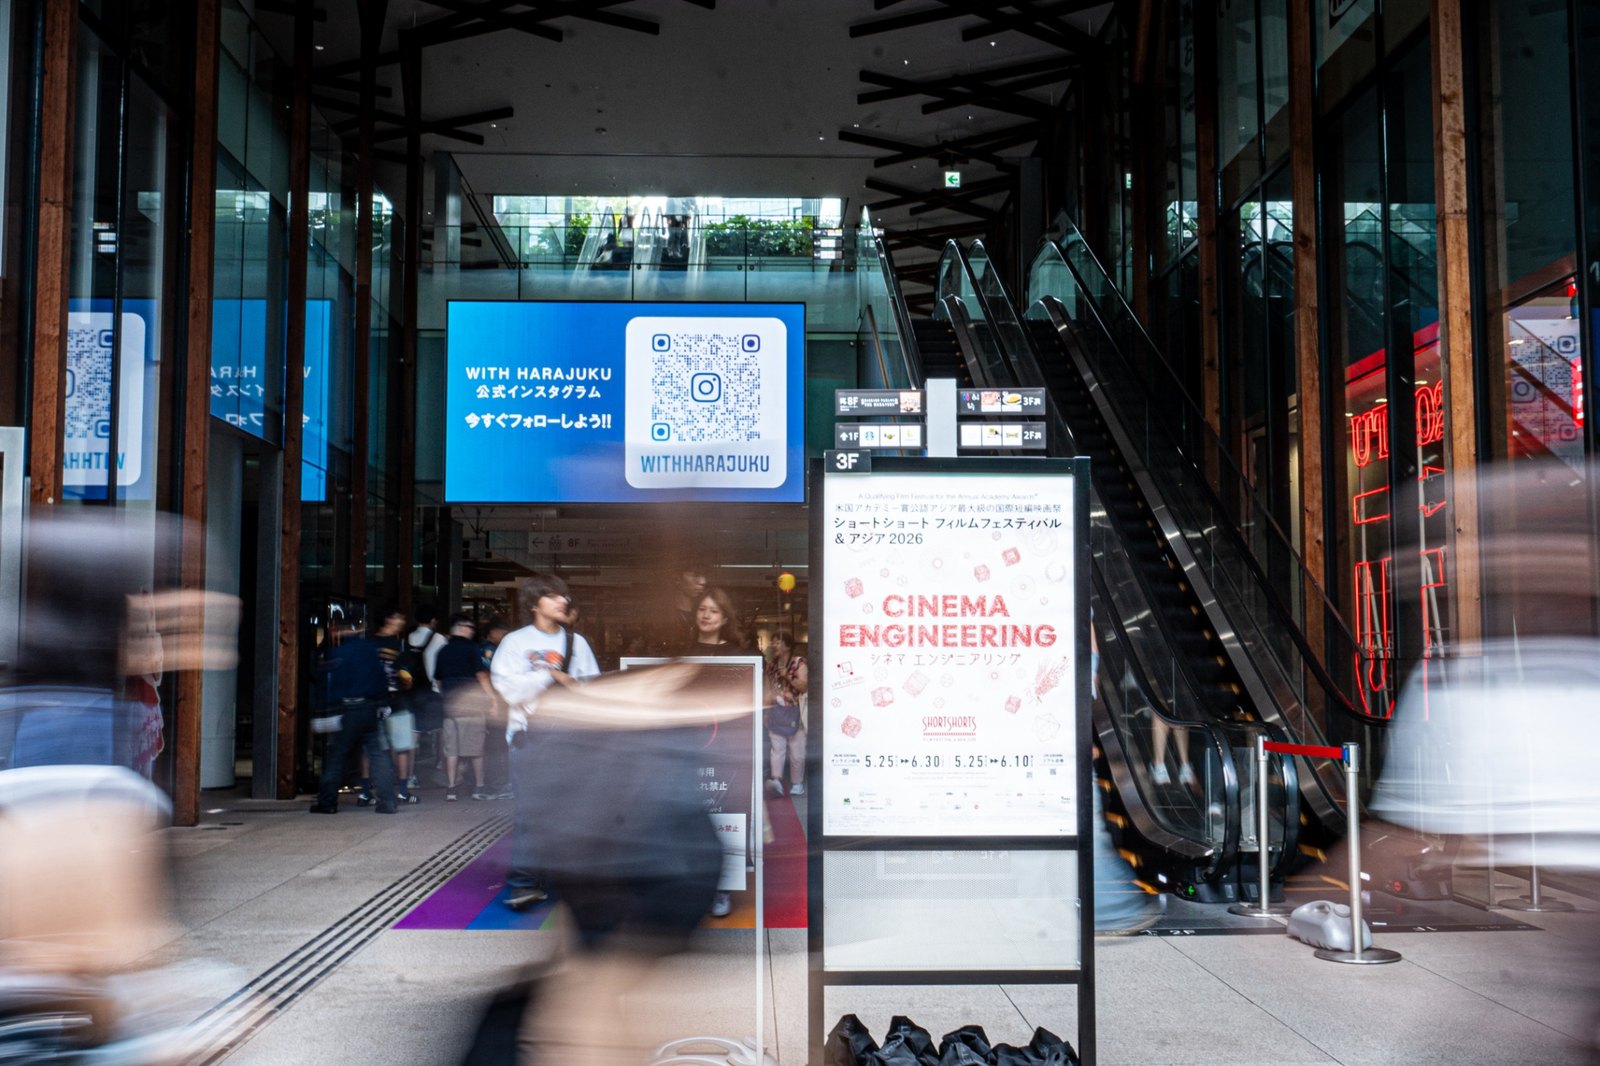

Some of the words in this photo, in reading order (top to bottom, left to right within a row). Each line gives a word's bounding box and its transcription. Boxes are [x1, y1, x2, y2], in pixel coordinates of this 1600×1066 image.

[465, 366, 509, 381] WITH
[516, 366, 612, 381] HARAJUKU
[476, 384, 601, 399] 公式インスタグラム
[847, 396, 859, 406] 8F
[1022, 397, 1034, 406] 3F
[465, 413, 612, 430] 今すぐフォローしよう!!
[848, 432, 859, 441] 1F
[1023, 431, 1035, 440] 2F
[640, 454, 770, 474] WITHHARAJUKU
[835, 453, 859, 470] 3F
[834, 503, 1062, 514] 米国アカデミー賞公認アジア最大級の国際短編映画祭
[834, 517, 929, 529] ショートショート
[935, 517, 1062, 530] フィルムフェスティバル
[568, 538, 580, 548] 8F
[834, 533, 845, 545] &
[849, 533, 885, 545] アジア
[889, 533, 923, 545] 2026
[882, 594, 1010, 618] CINEMA
[839, 624, 1057, 648] ENGINEERING
[870, 653, 906, 666] シネマ
[913, 653, 1021, 666] エンジニアリング
[865, 755, 894, 768] 5.25
[911, 755, 940, 768] 6.30
[955, 755, 983, 768] 5.25
[1000, 755, 1029, 768] 6.10
